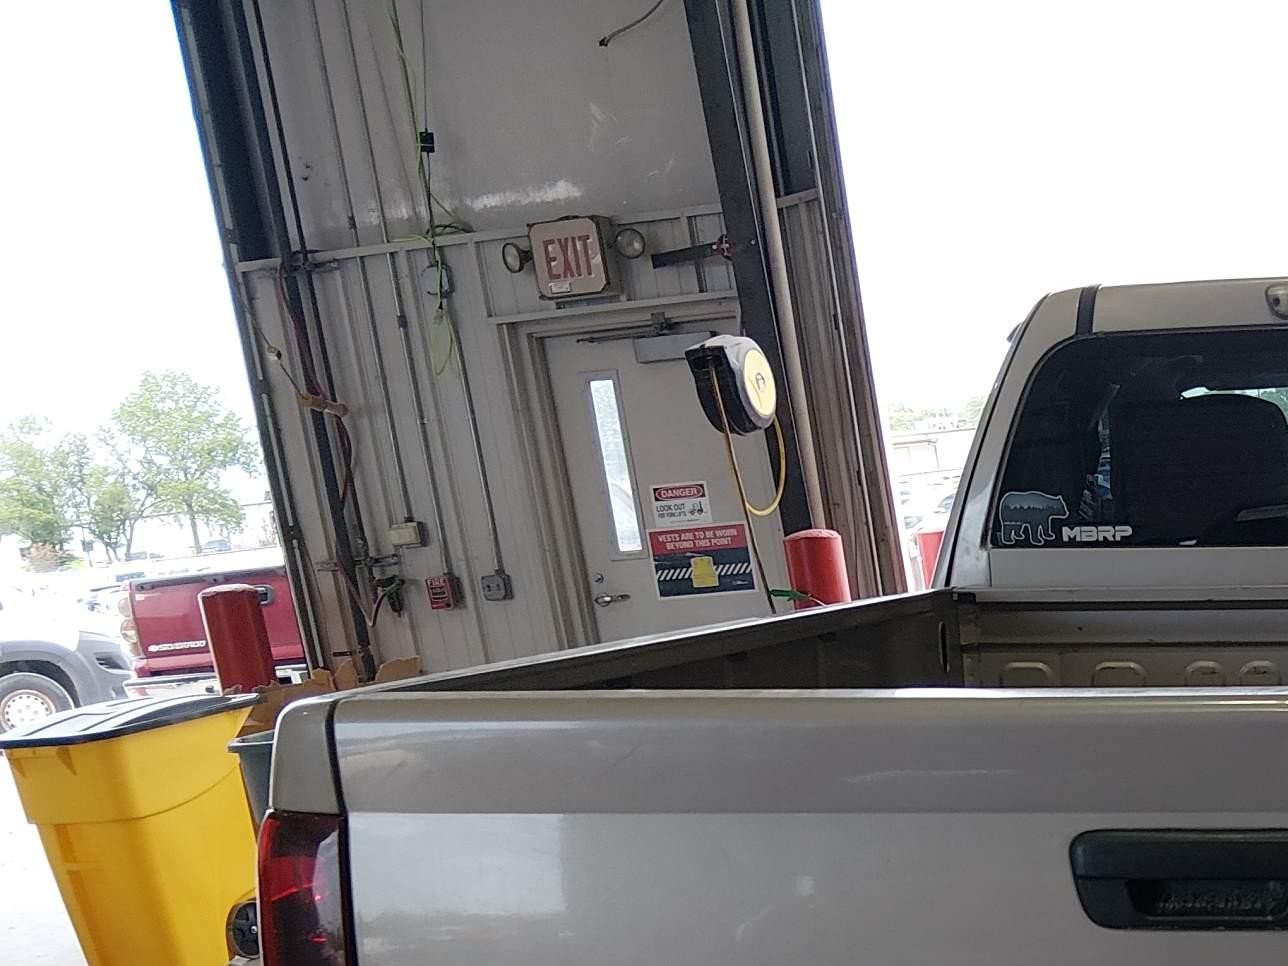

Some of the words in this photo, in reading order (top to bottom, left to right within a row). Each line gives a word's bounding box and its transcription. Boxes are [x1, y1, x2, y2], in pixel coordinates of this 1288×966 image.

[543, 234, 593, 281] EXIT
[660, 487, 698, 499] DANGER
[656, 504, 673, 512] LOOK
[673, 503, 685, 511] OUT
[657, 533, 680, 543] VESTS
[681, 532, 695, 541] ARE
[695, 531, 705, 539] TO
[705, 530, 715, 538] BE
[715, 529, 737, 537] WORN
[1061, 525, 1133, 542] MBRP
[666, 540, 694, 550] BEYOND
[694, 539, 711, 548] THIS
[711, 537, 732, 546] POINT
[427, 577, 449, 586] FIRE
